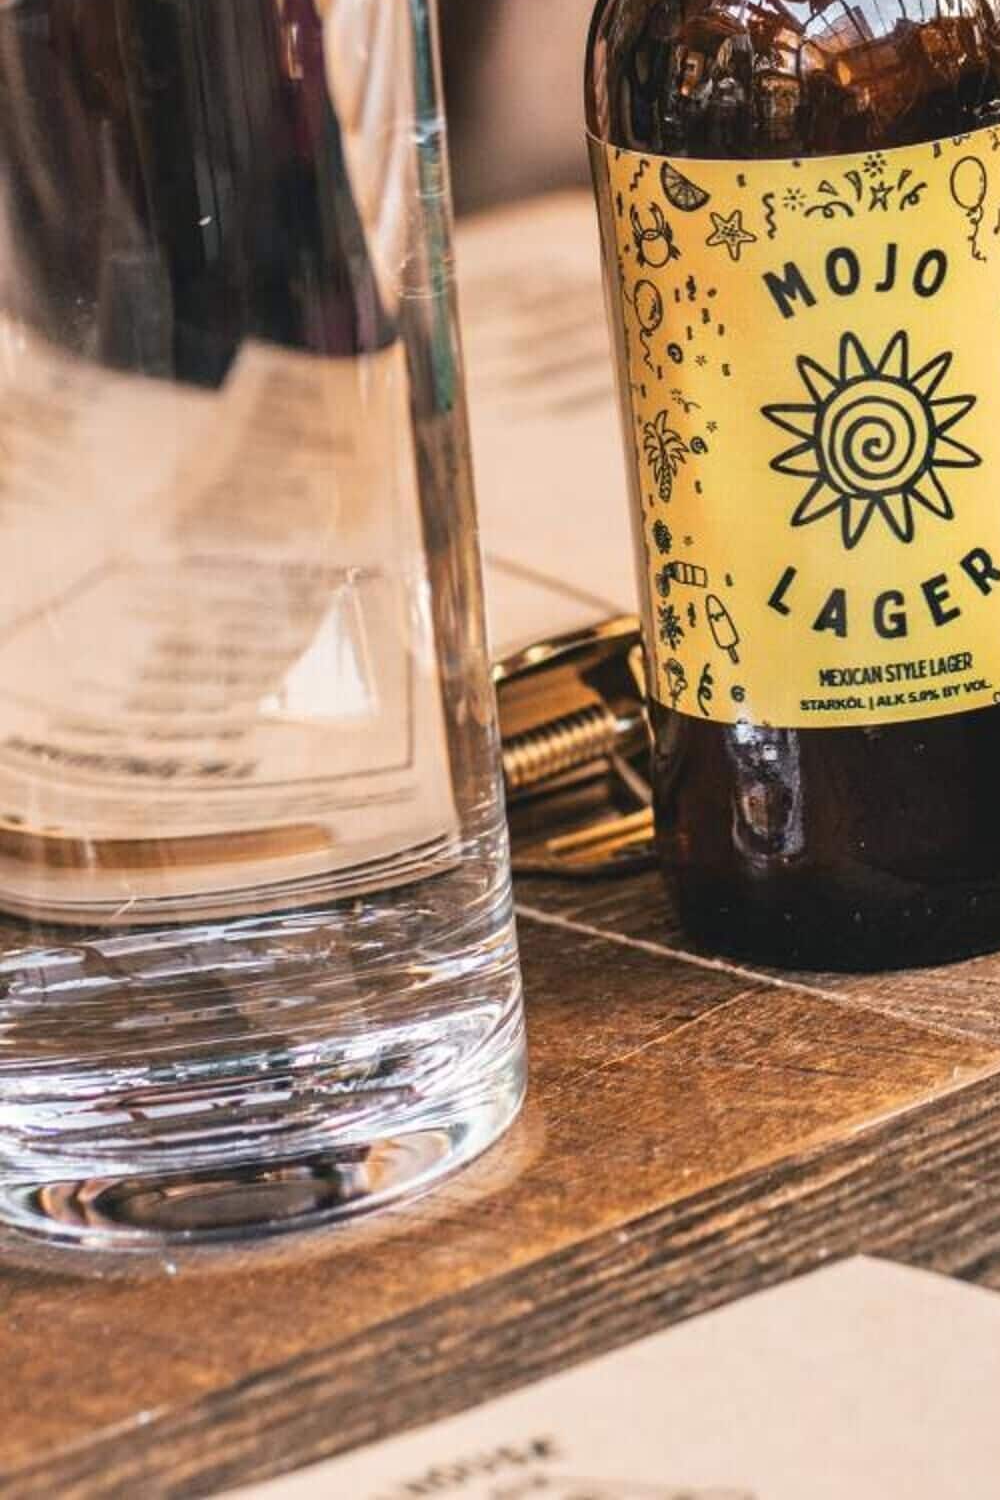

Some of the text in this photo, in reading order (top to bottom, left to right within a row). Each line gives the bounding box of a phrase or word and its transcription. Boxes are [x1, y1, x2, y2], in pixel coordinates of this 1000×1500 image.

[762, 243, 948, 319] MOJO
[819, 652, 973, 687] MEXICAN STYLE LAGER
[942, 684, 961, 698] BY
